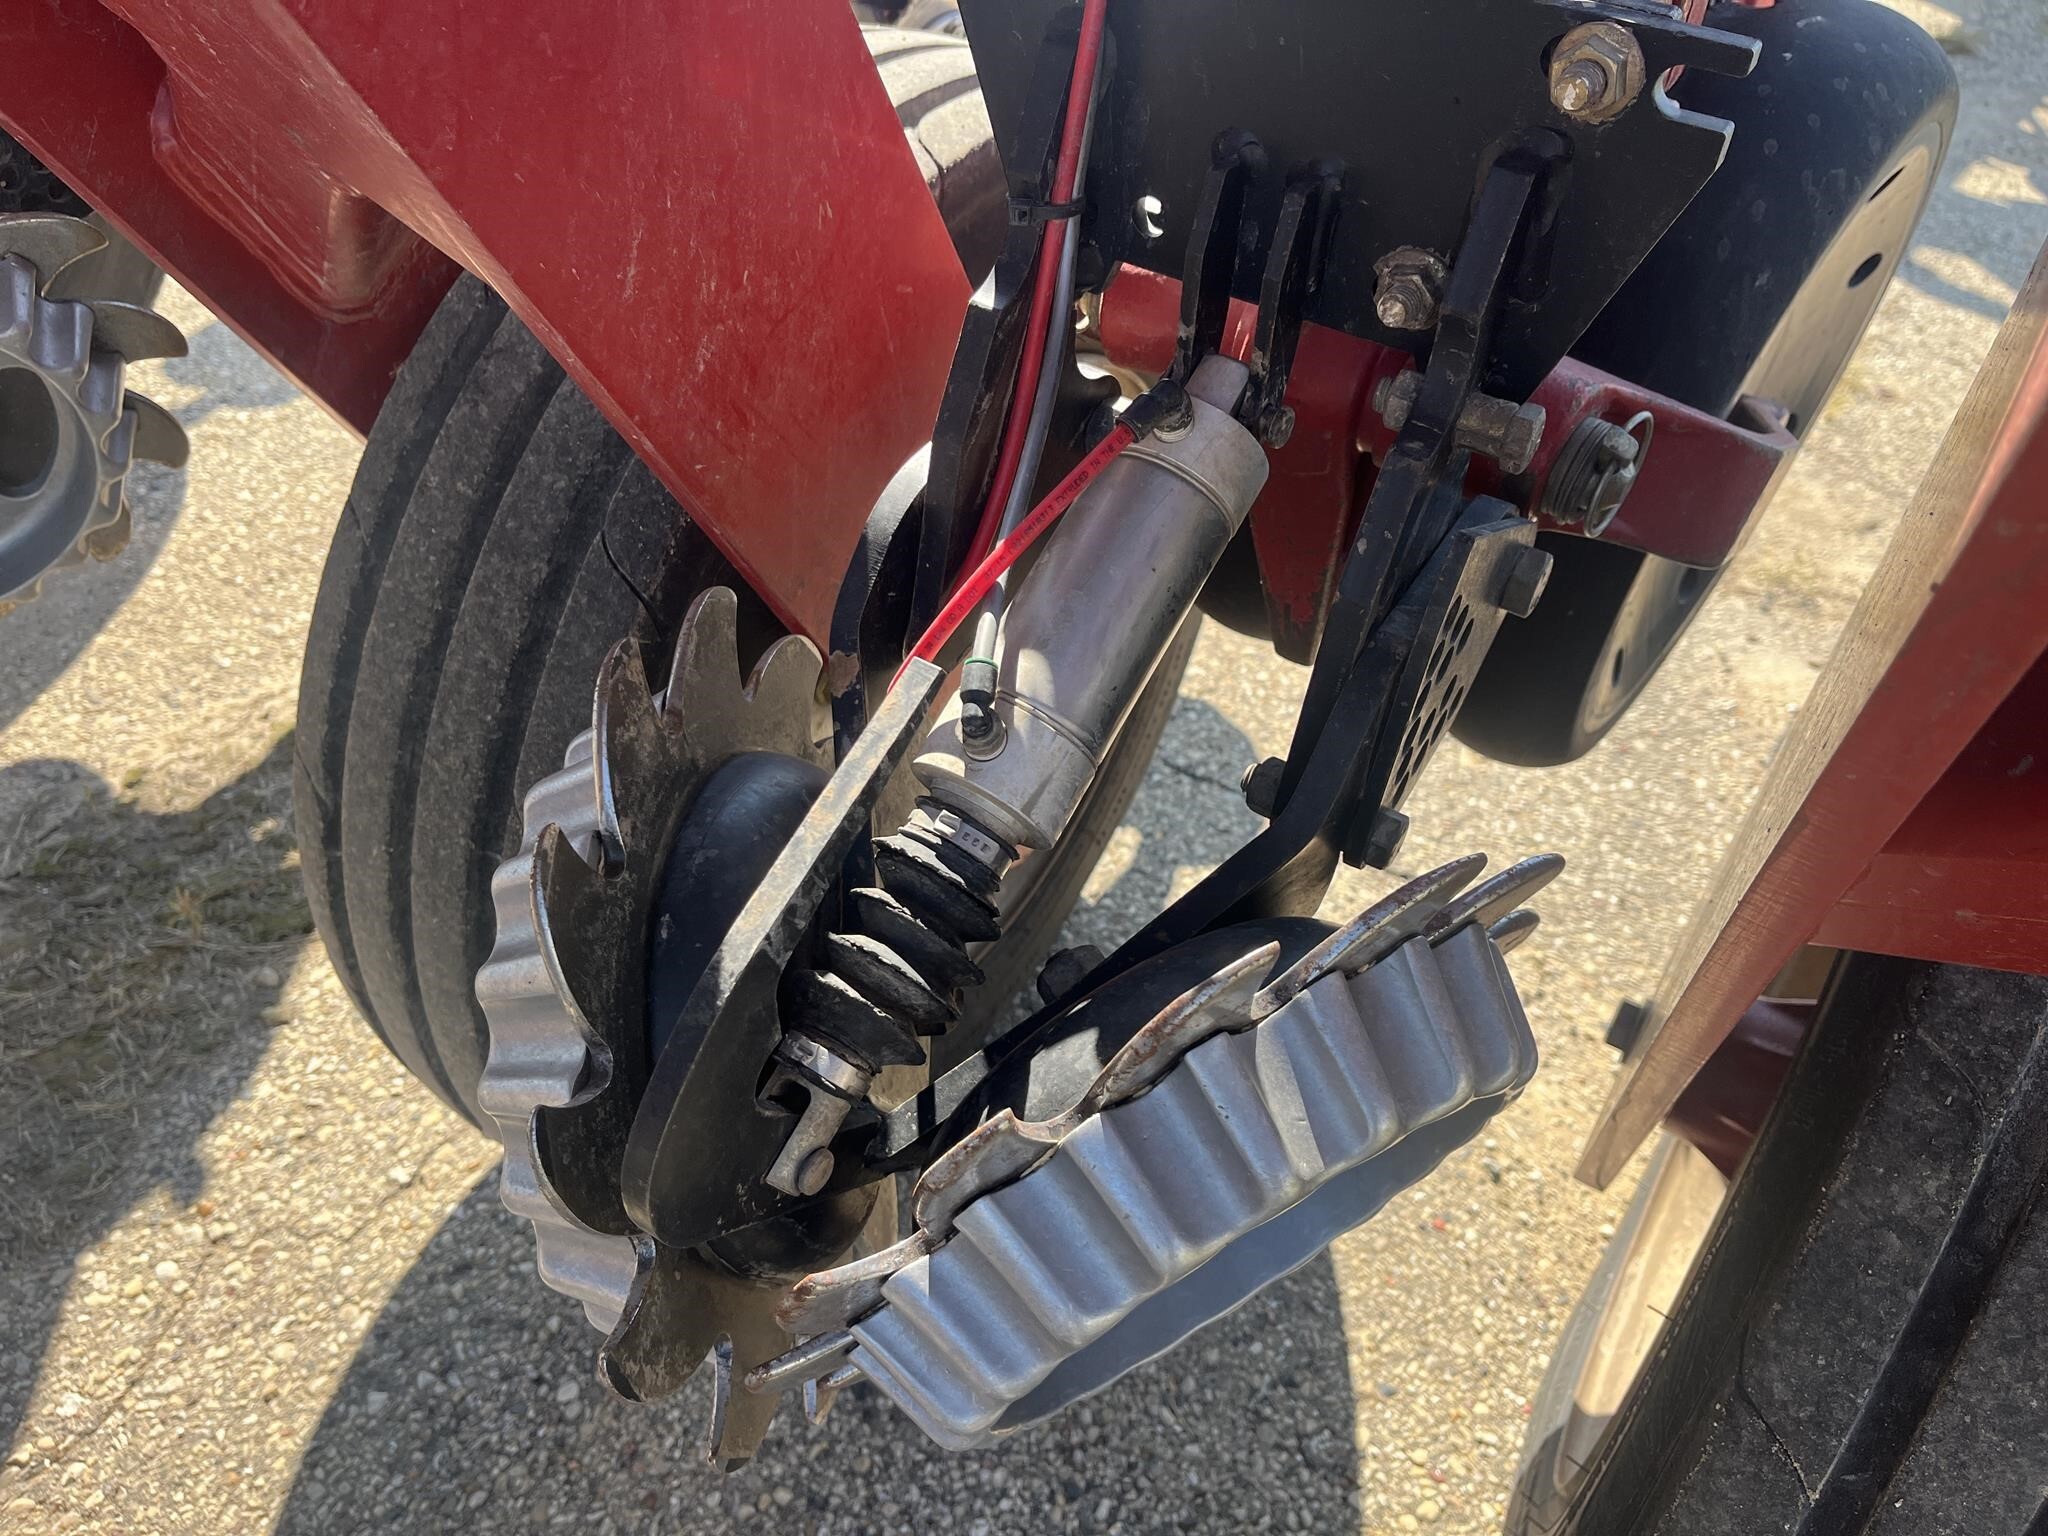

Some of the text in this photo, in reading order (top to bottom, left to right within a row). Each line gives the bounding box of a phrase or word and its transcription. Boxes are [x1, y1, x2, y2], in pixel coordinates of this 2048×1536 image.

[1055, 470, 1089, 503] EXTRUDED
[1089, 457, 1102, 471] IN
[1101, 443, 1116, 458] THE
